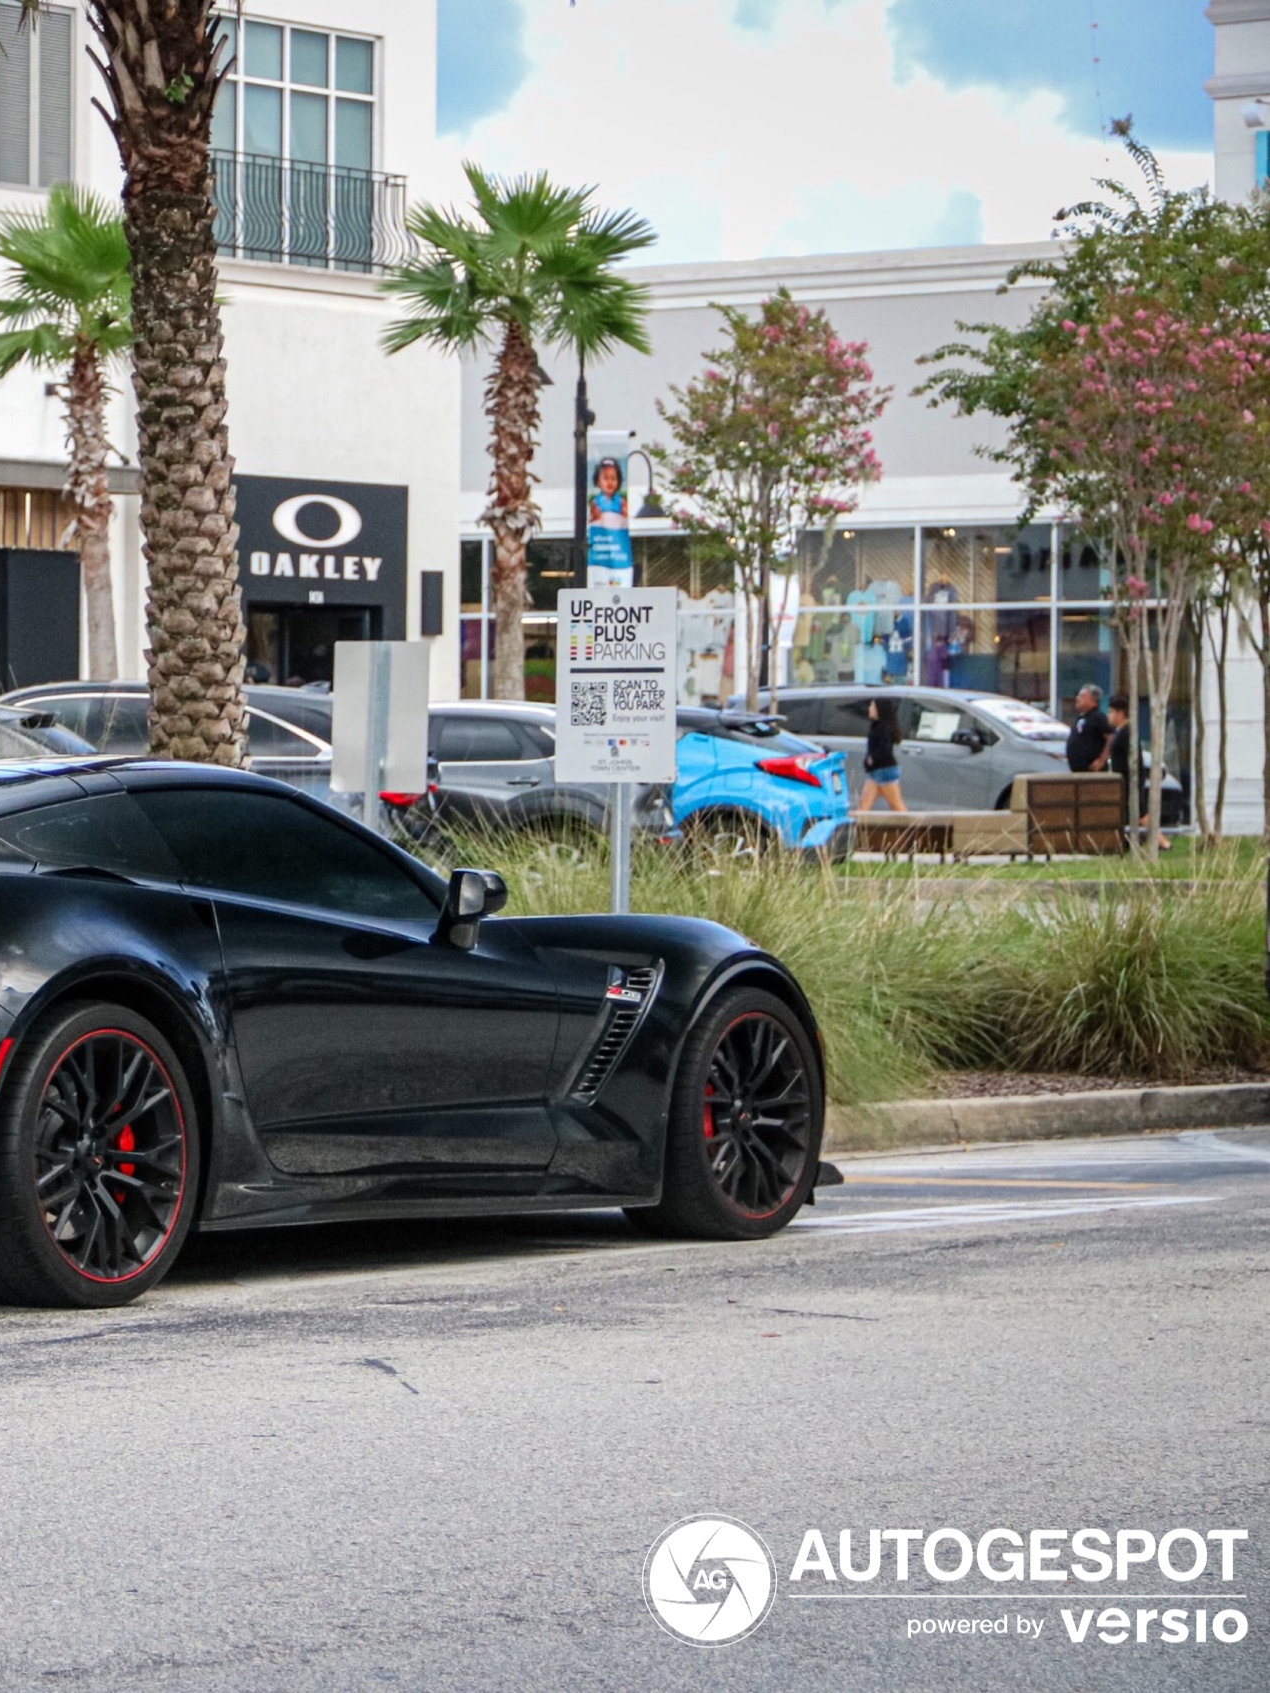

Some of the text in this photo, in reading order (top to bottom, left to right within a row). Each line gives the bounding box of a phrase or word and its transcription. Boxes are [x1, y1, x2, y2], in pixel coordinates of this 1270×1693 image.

[250, 551, 383, 581] OAKLEY
[570, 600, 654, 624] UP FRONT
[594, 625, 637, 642] PLUS
[593, 642, 666, 661] PARKING
[612, 679, 658, 690] SCAN TO
[612, 689, 666, 700] PAY AFTER
[612, 700, 666, 710] YOU PARK.
[612, 714, 631, 723] Enjoy
[632, 715, 648, 723] your
